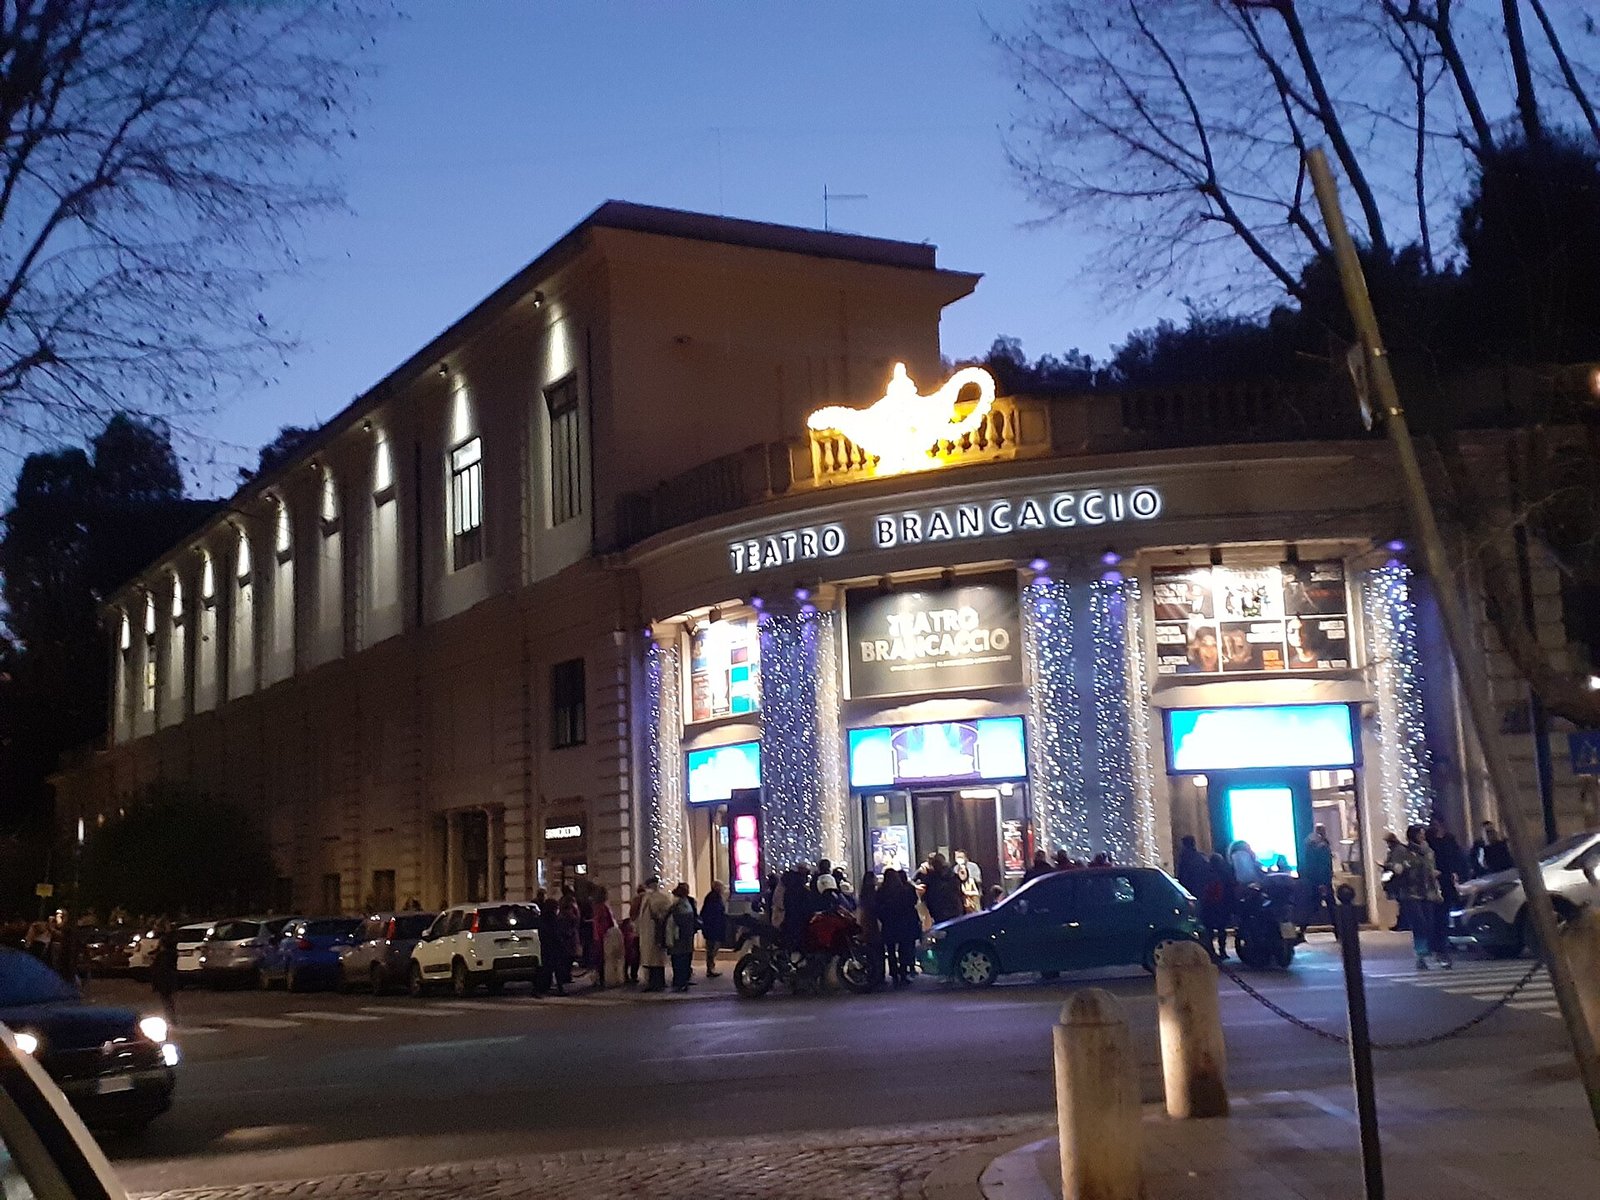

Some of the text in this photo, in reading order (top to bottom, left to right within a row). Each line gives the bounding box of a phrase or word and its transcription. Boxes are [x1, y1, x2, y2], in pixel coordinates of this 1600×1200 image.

[728, 489, 1161, 574] TEATRO BRANCACCIO
[887, 606, 980, 637] TATRO
[861, 628, 1010, 662] BRANCACCIO
